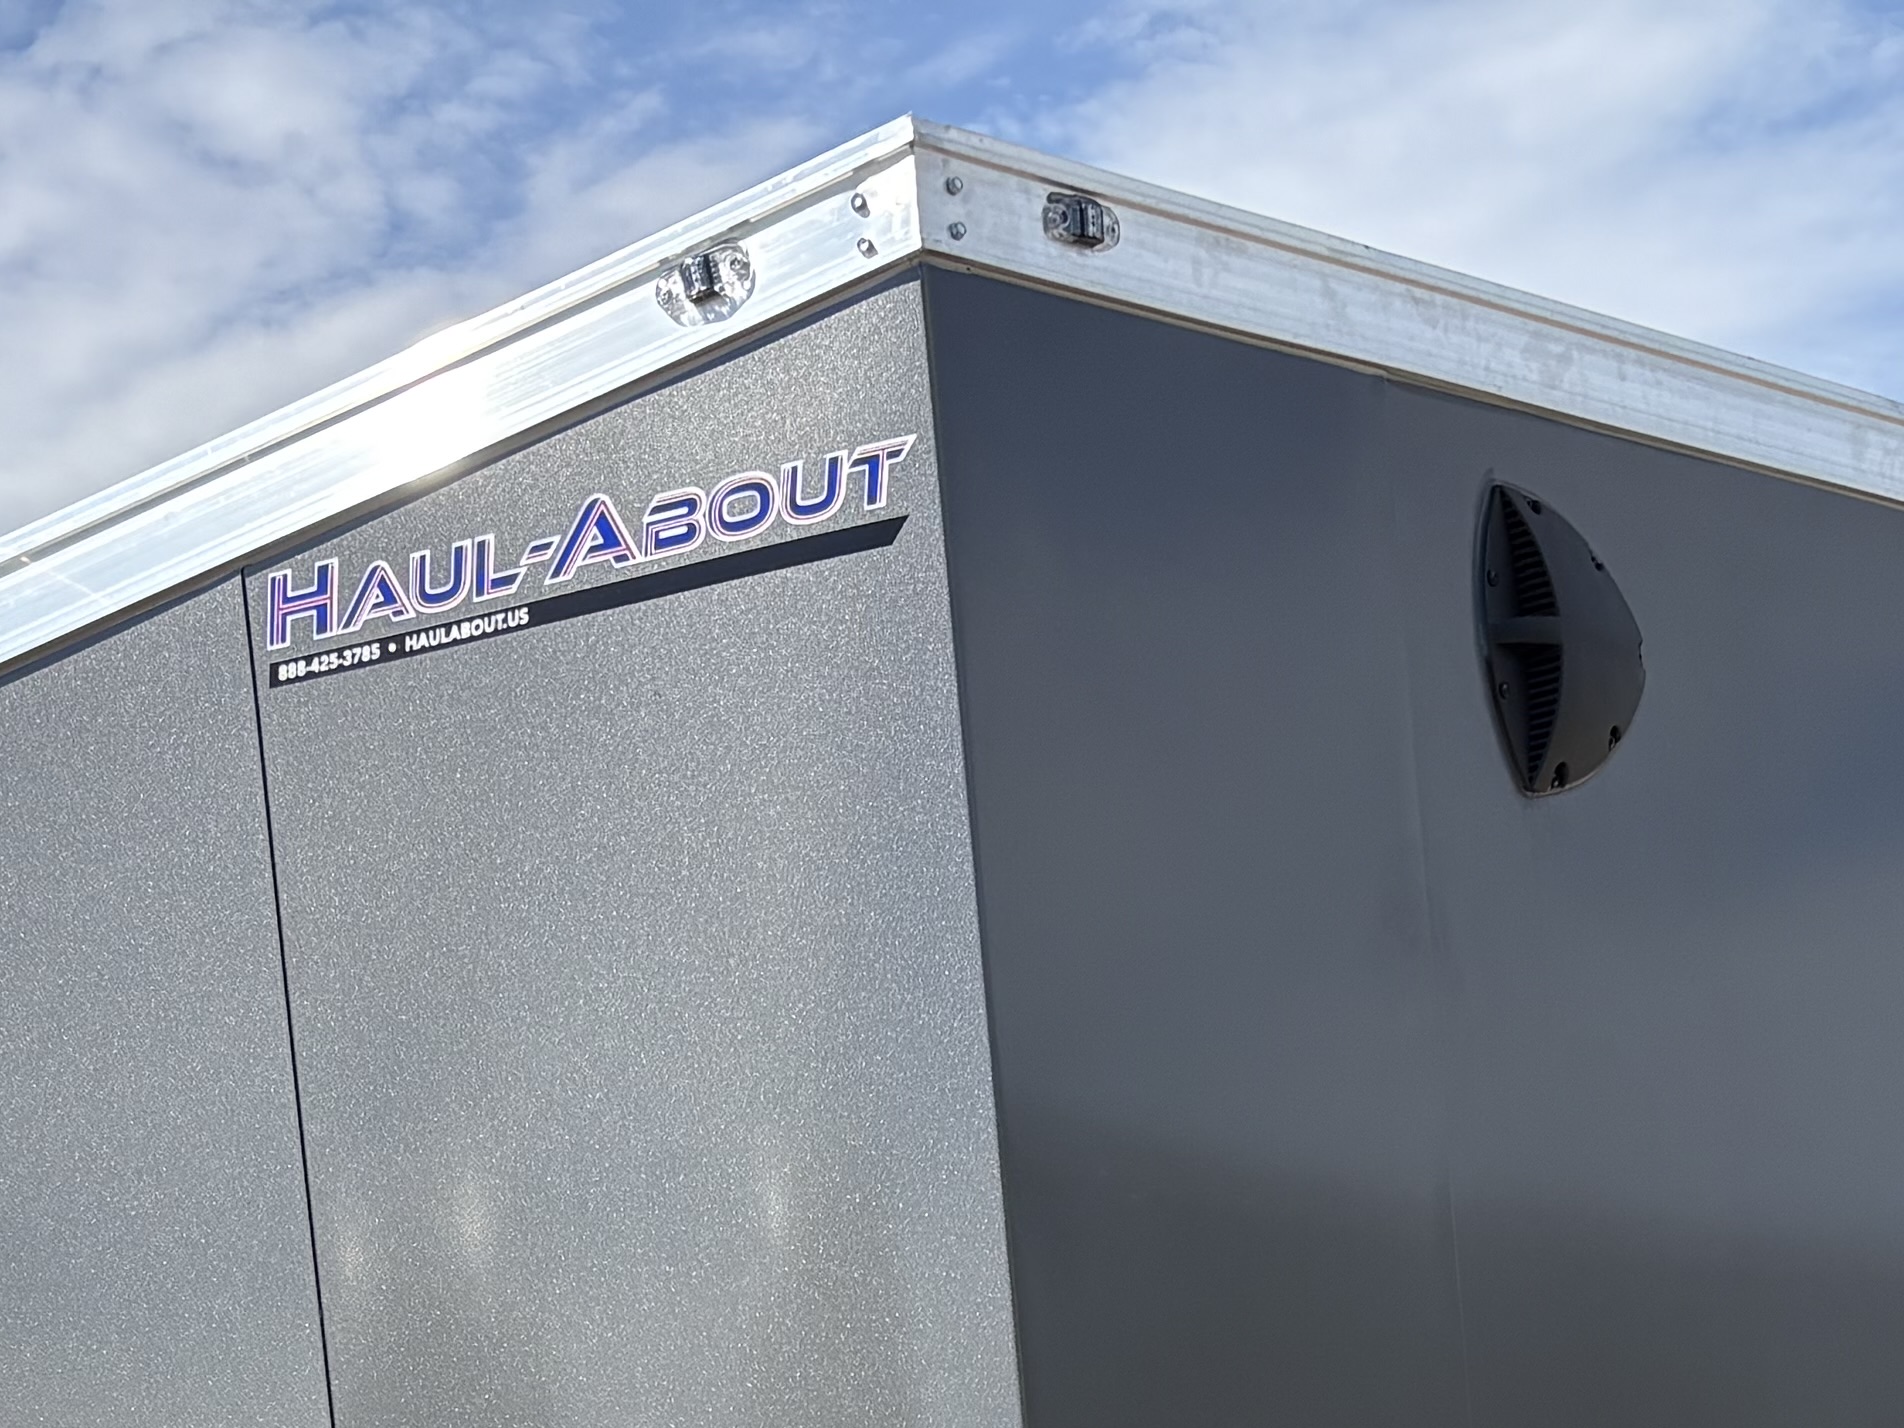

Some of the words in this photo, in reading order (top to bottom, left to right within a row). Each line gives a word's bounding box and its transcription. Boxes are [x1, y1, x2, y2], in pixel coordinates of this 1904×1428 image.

[266, 434, 917, 651] HAUL-ABOUT
[277, 643, 381, 681] 888-425-3785
[405, 608, 530, 652] HAULABOUT.US
